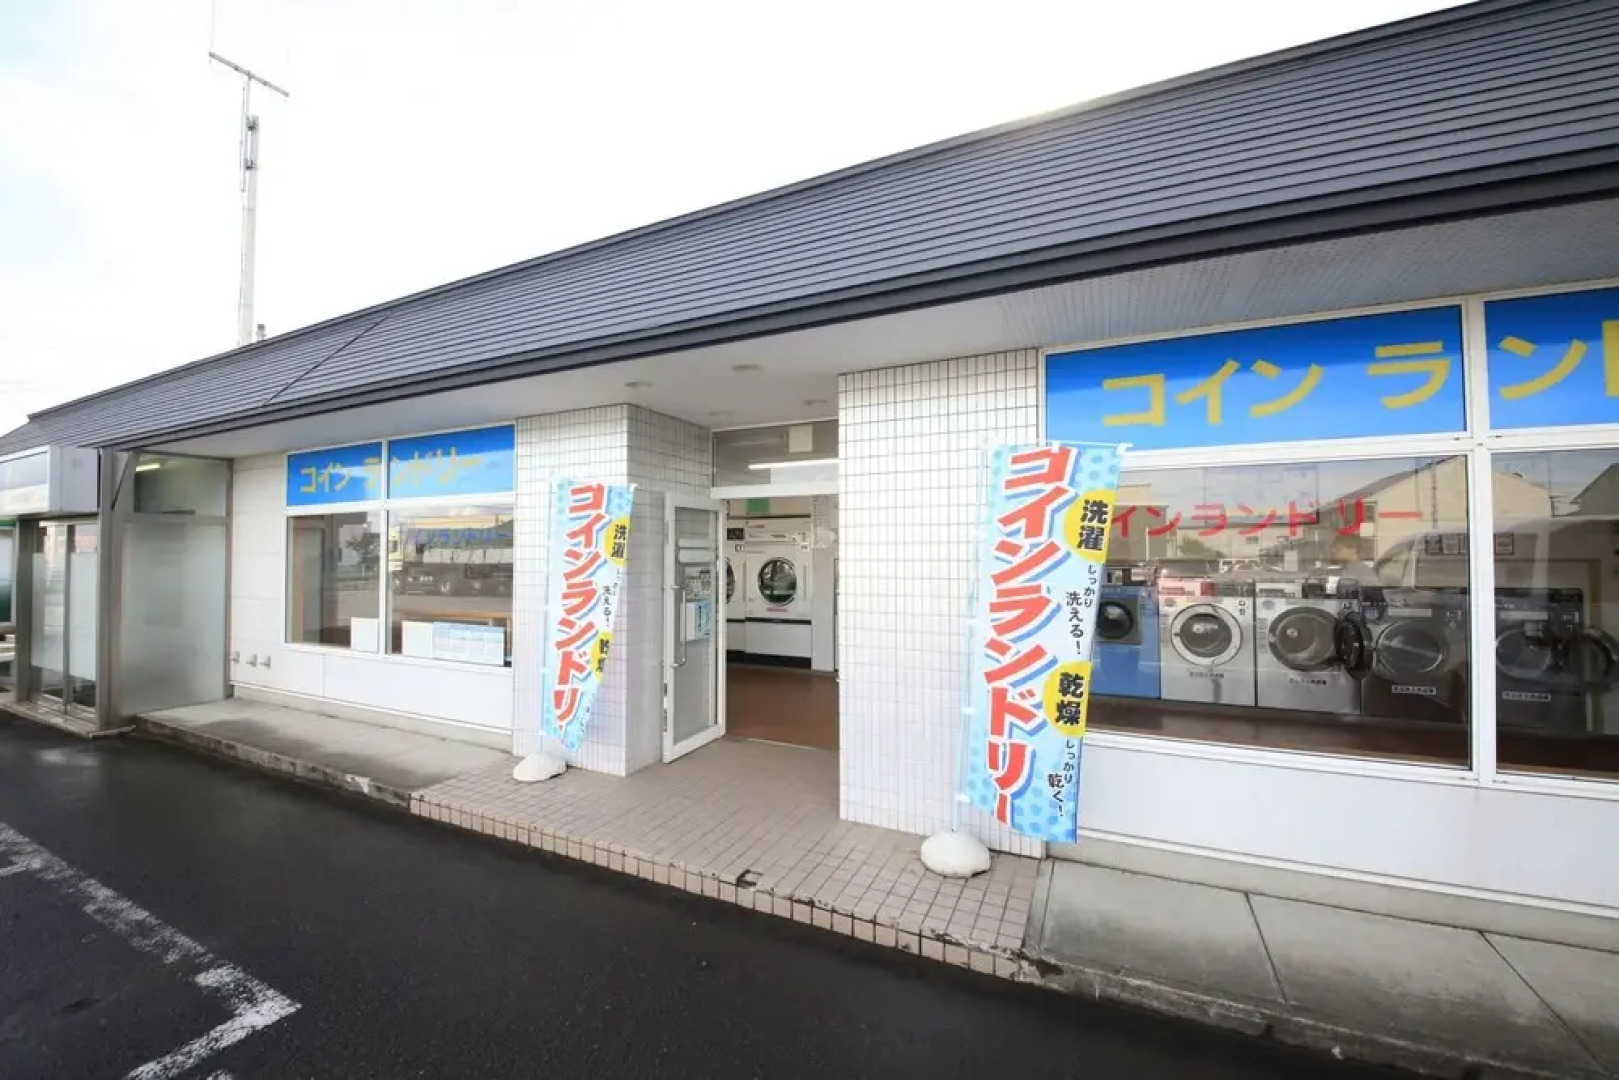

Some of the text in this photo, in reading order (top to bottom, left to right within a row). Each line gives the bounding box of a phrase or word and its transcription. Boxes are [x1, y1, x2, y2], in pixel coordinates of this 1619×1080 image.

[1077, 499, 1108, 551] 洗濯
[1111, 495, 1423, 537] インランドリー
[553, 483, 605, 730] コインランドリ
[1083, 564, 1098, 608] しっかり
[984, 446, 1070, 824] コインランドリー
[1055, 671, 1085, 726] 乾燥
[1063, 738, 1076, 784] しっかり
